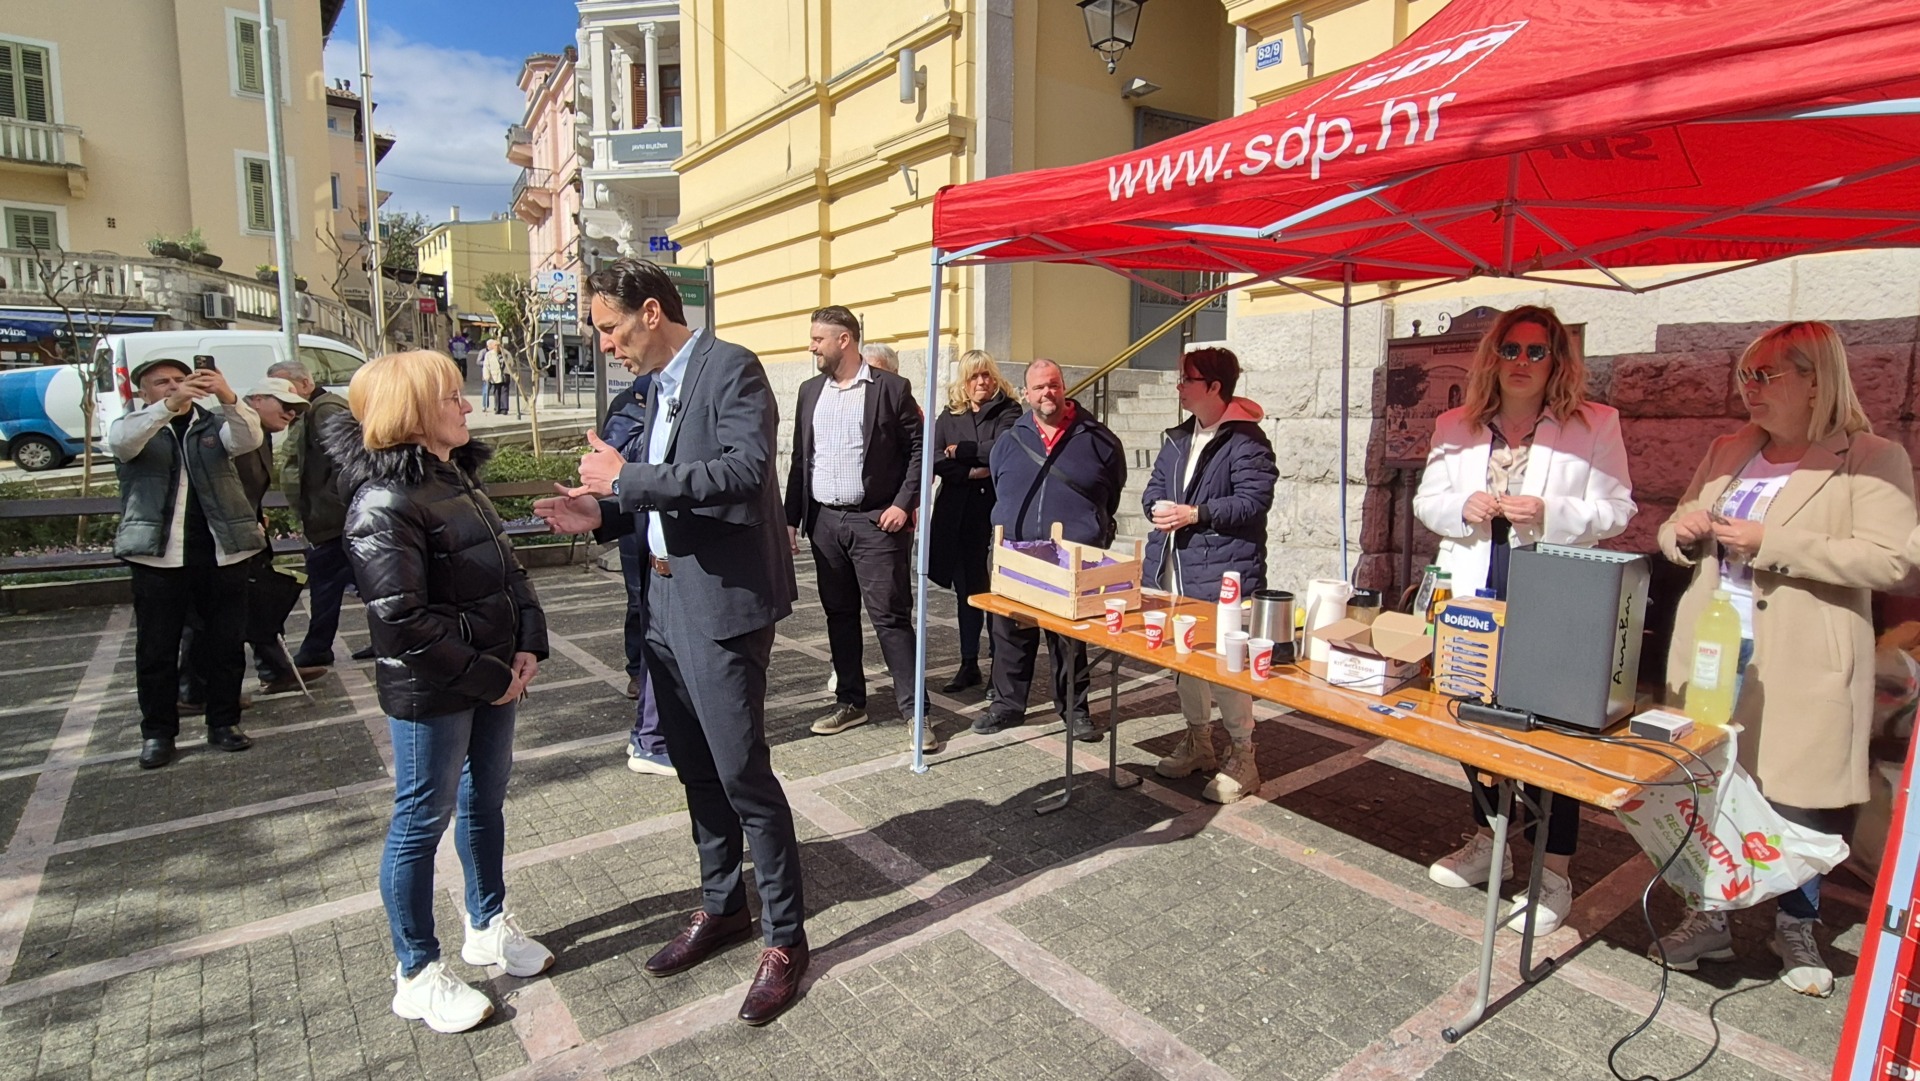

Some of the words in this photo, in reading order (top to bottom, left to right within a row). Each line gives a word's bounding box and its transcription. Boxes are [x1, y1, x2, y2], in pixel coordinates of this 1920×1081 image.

[1258, 43, 1280, 61] 82/9
[1108, 92, 1457, 201] www.sdp.hr
[1445, 613, 1490, 632] BORBONE
